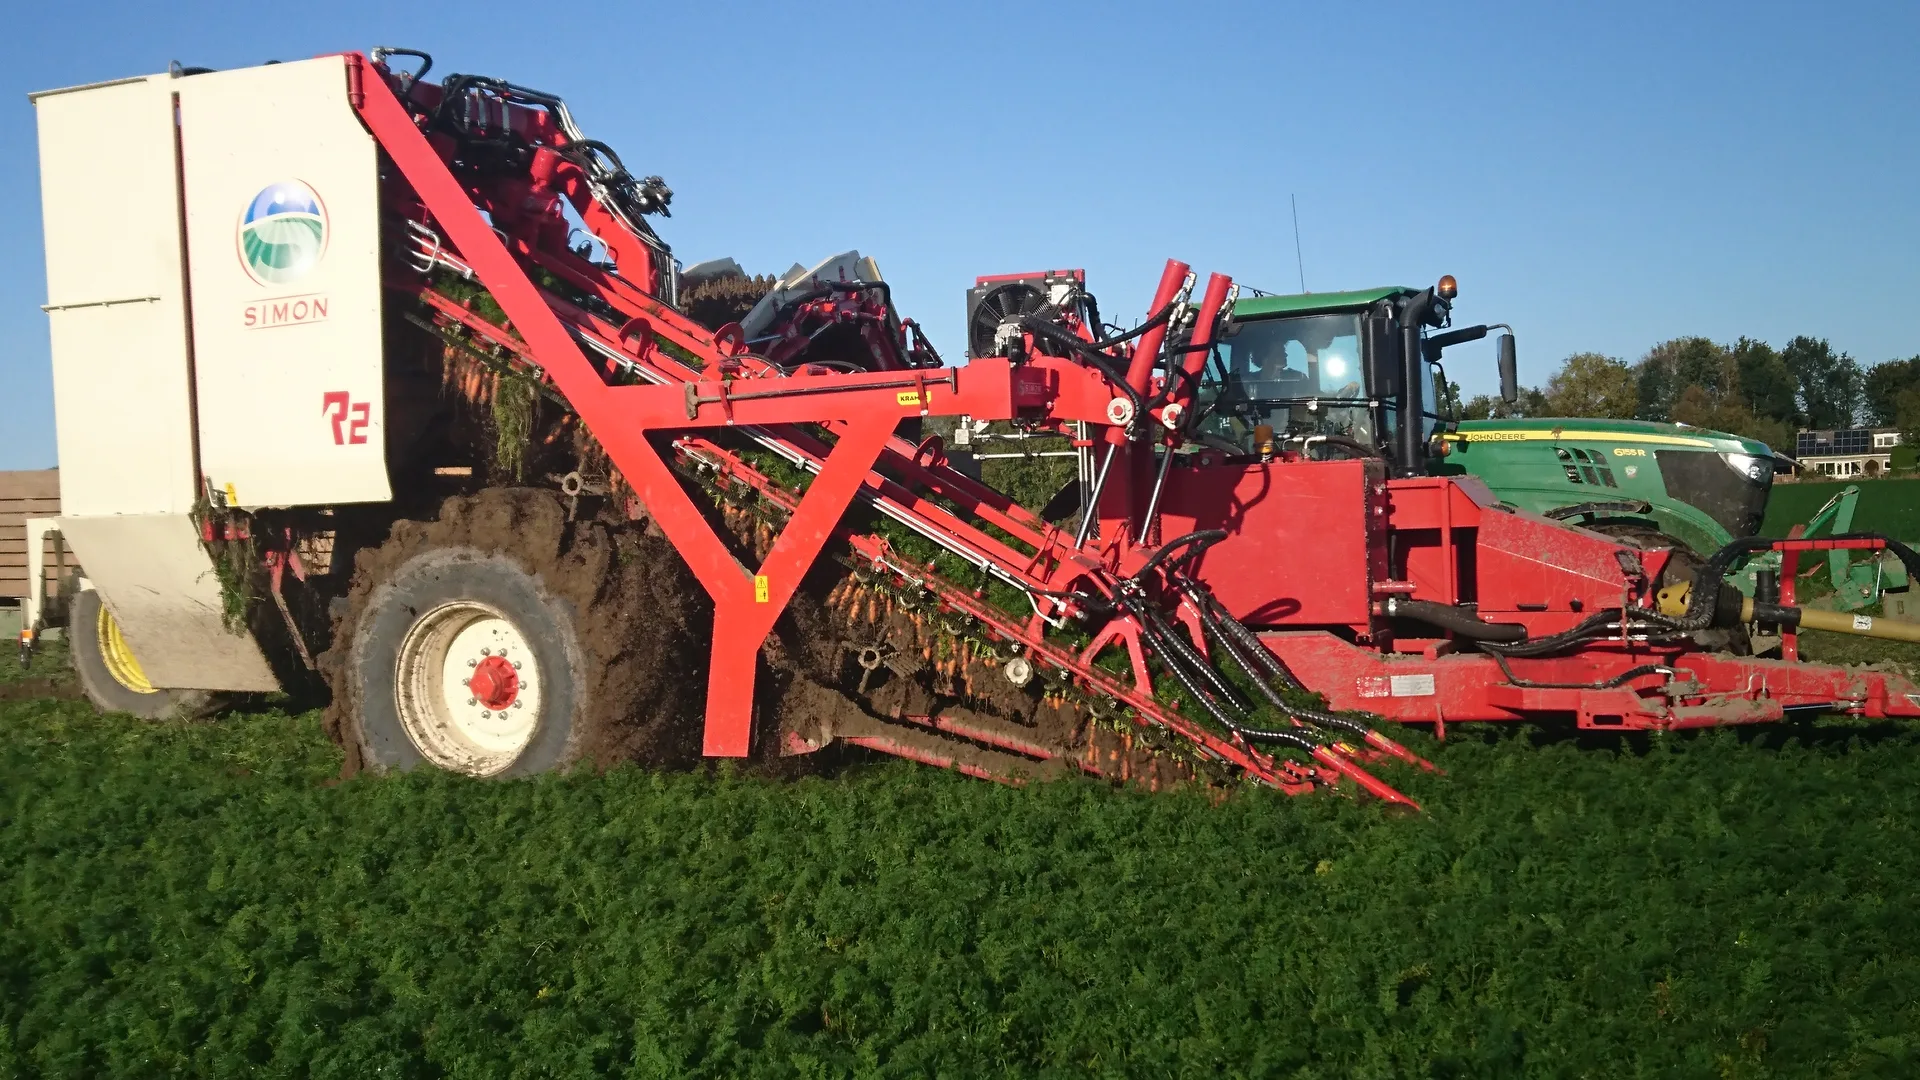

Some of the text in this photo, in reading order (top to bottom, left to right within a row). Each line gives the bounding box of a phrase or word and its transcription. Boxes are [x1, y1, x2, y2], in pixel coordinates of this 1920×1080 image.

[243, 297, 328, 327] SIMON
[322, 391, 370, 445] R2
[1468, 432, 1526, 441] JOHN DEERE
